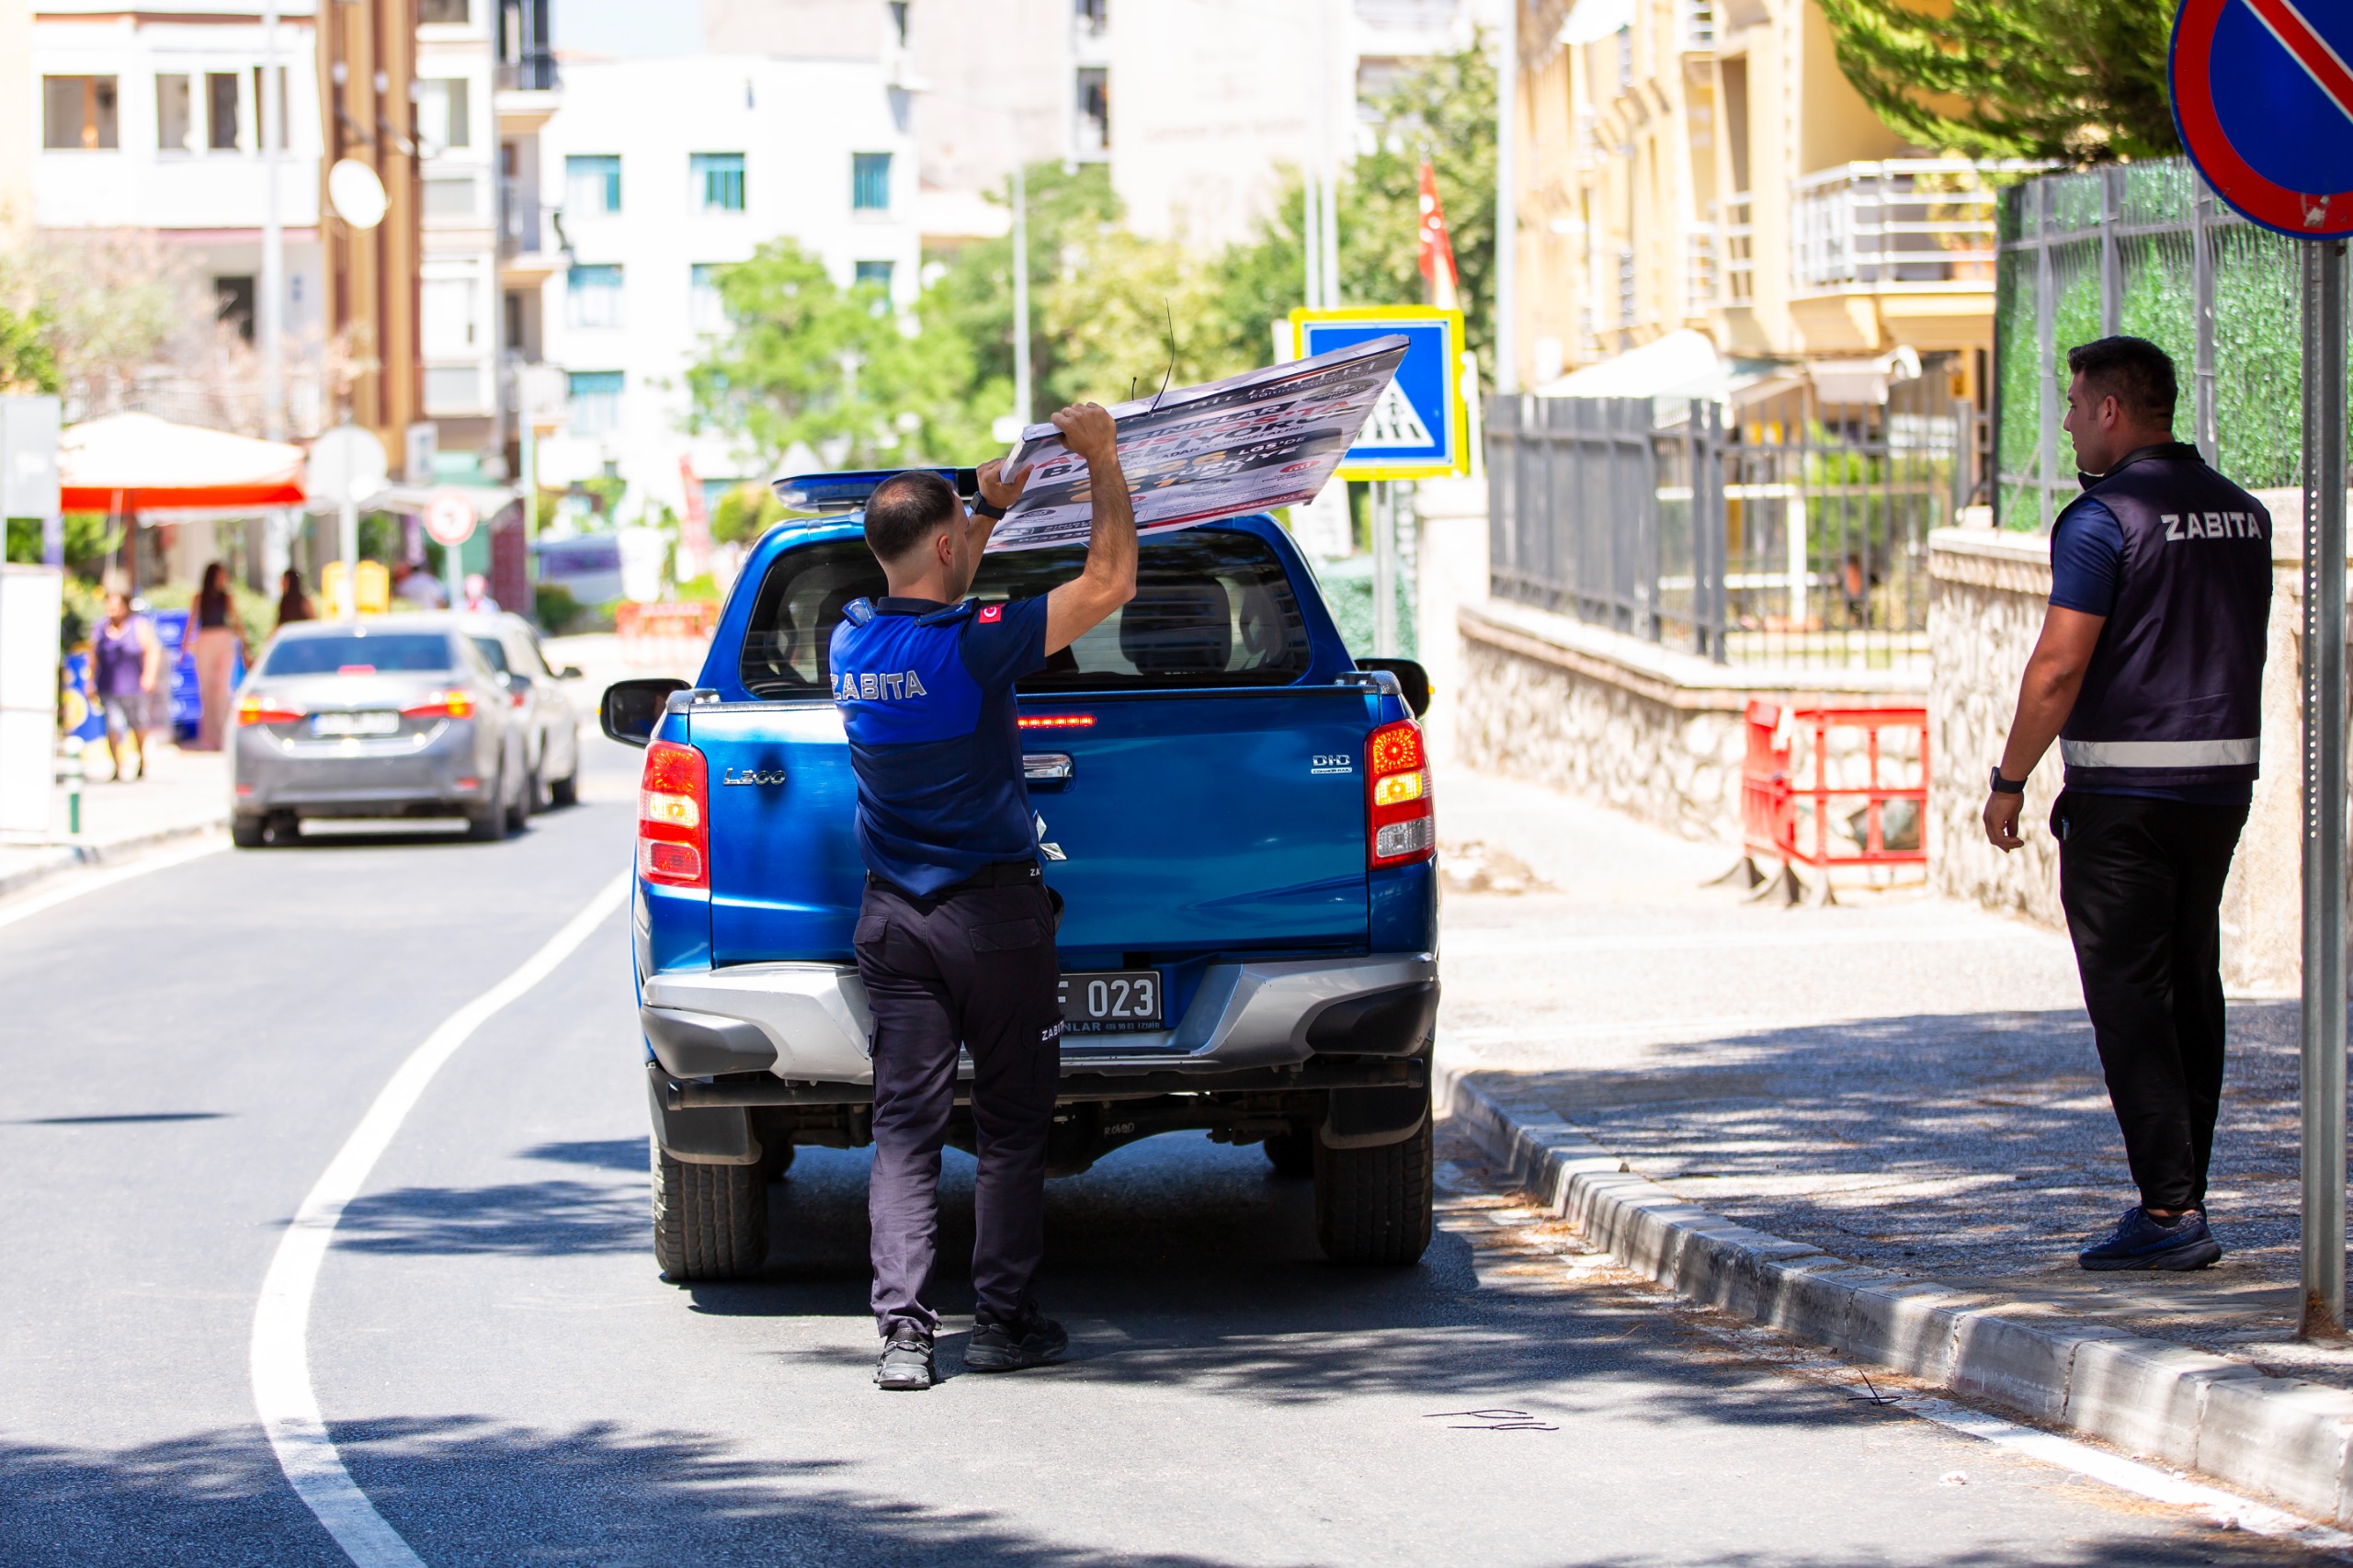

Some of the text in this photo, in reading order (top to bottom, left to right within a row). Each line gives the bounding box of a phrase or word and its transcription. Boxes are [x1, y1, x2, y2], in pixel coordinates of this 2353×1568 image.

[2160, 511, 2262, 541] ZABITA
[723, 767, 786, 786] L200
[1088, 979, 1154, 1017] 023
[1063, 1021, 1101, 1032] NLAR
